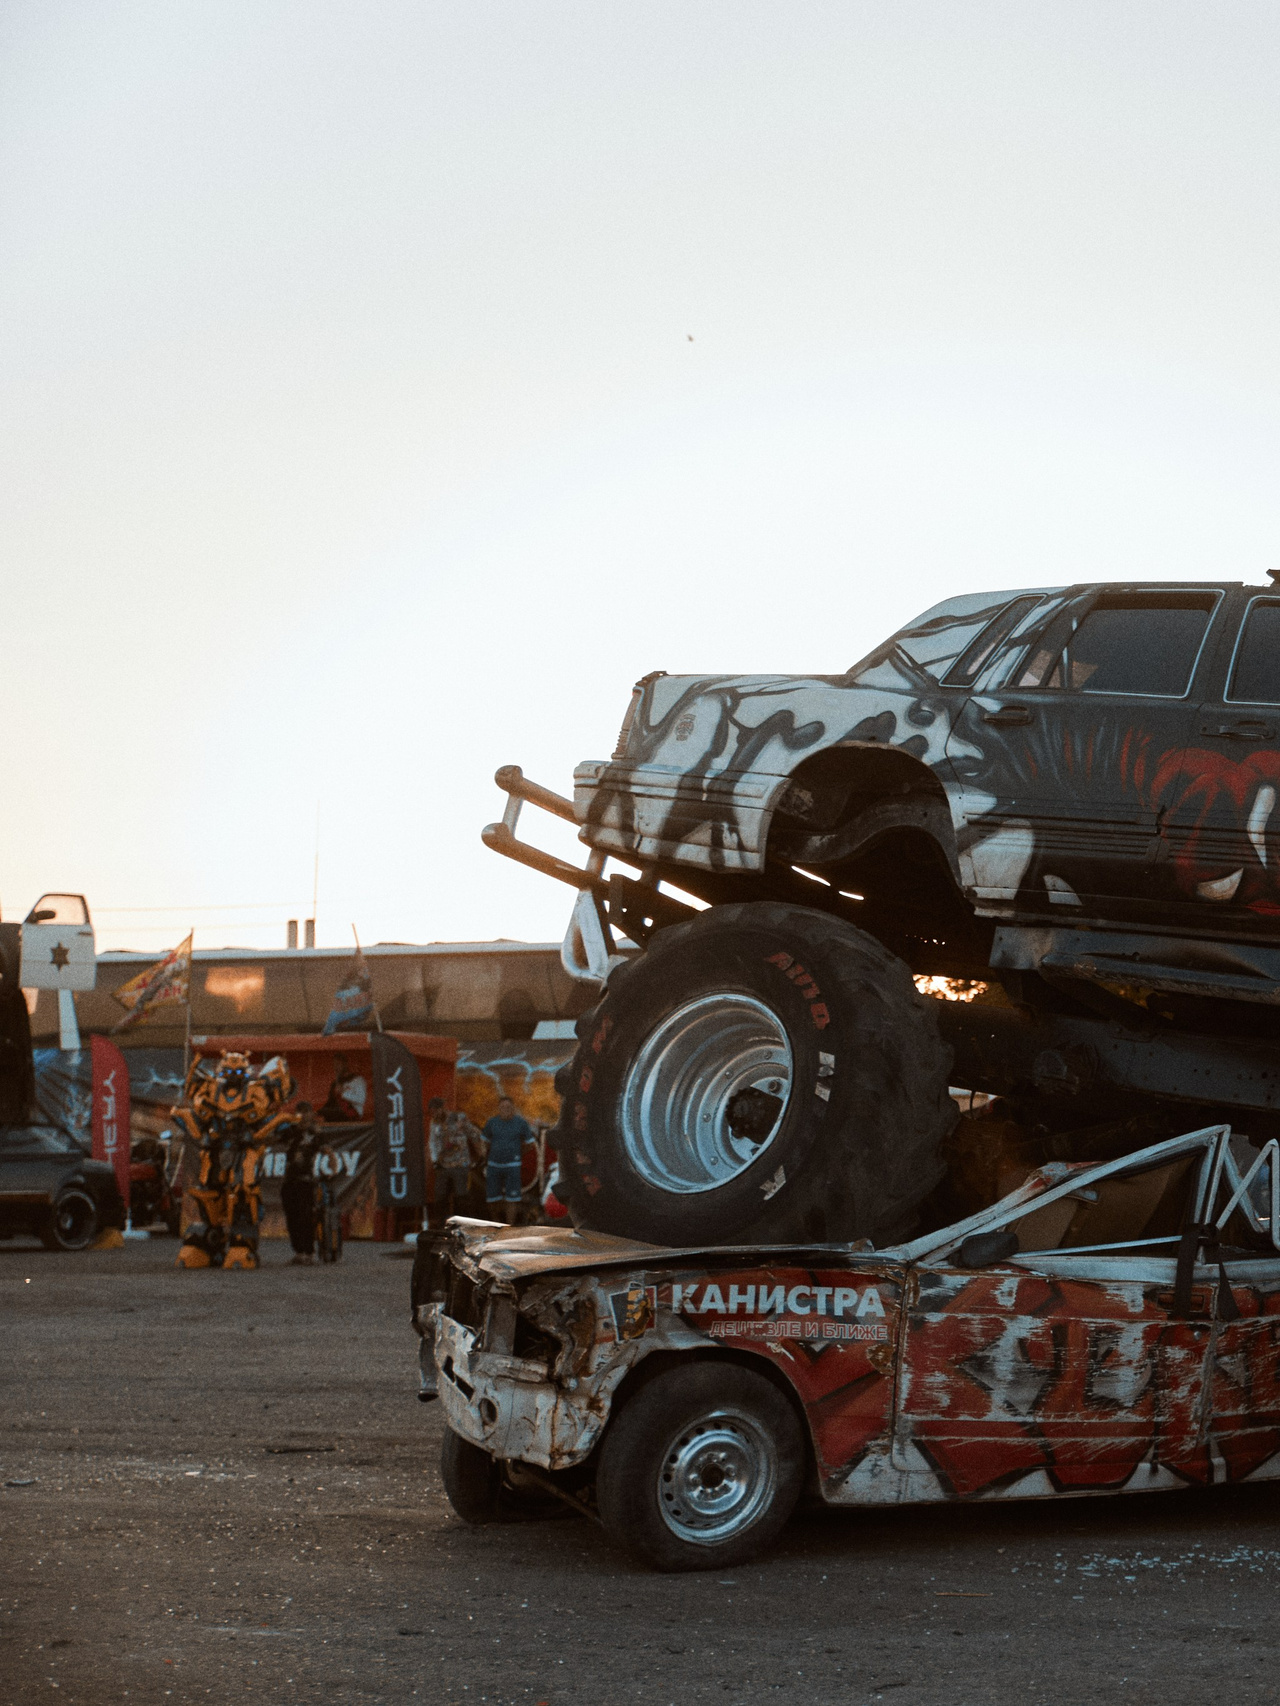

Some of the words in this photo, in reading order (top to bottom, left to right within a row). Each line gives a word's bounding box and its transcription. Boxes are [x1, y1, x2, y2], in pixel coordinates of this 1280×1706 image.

[671, 1283, 886, 1318] КАНИСТРА
[805, 1321, 819, 1338] И
[822, 1322, 888, 1341] БЛИЖЕ
